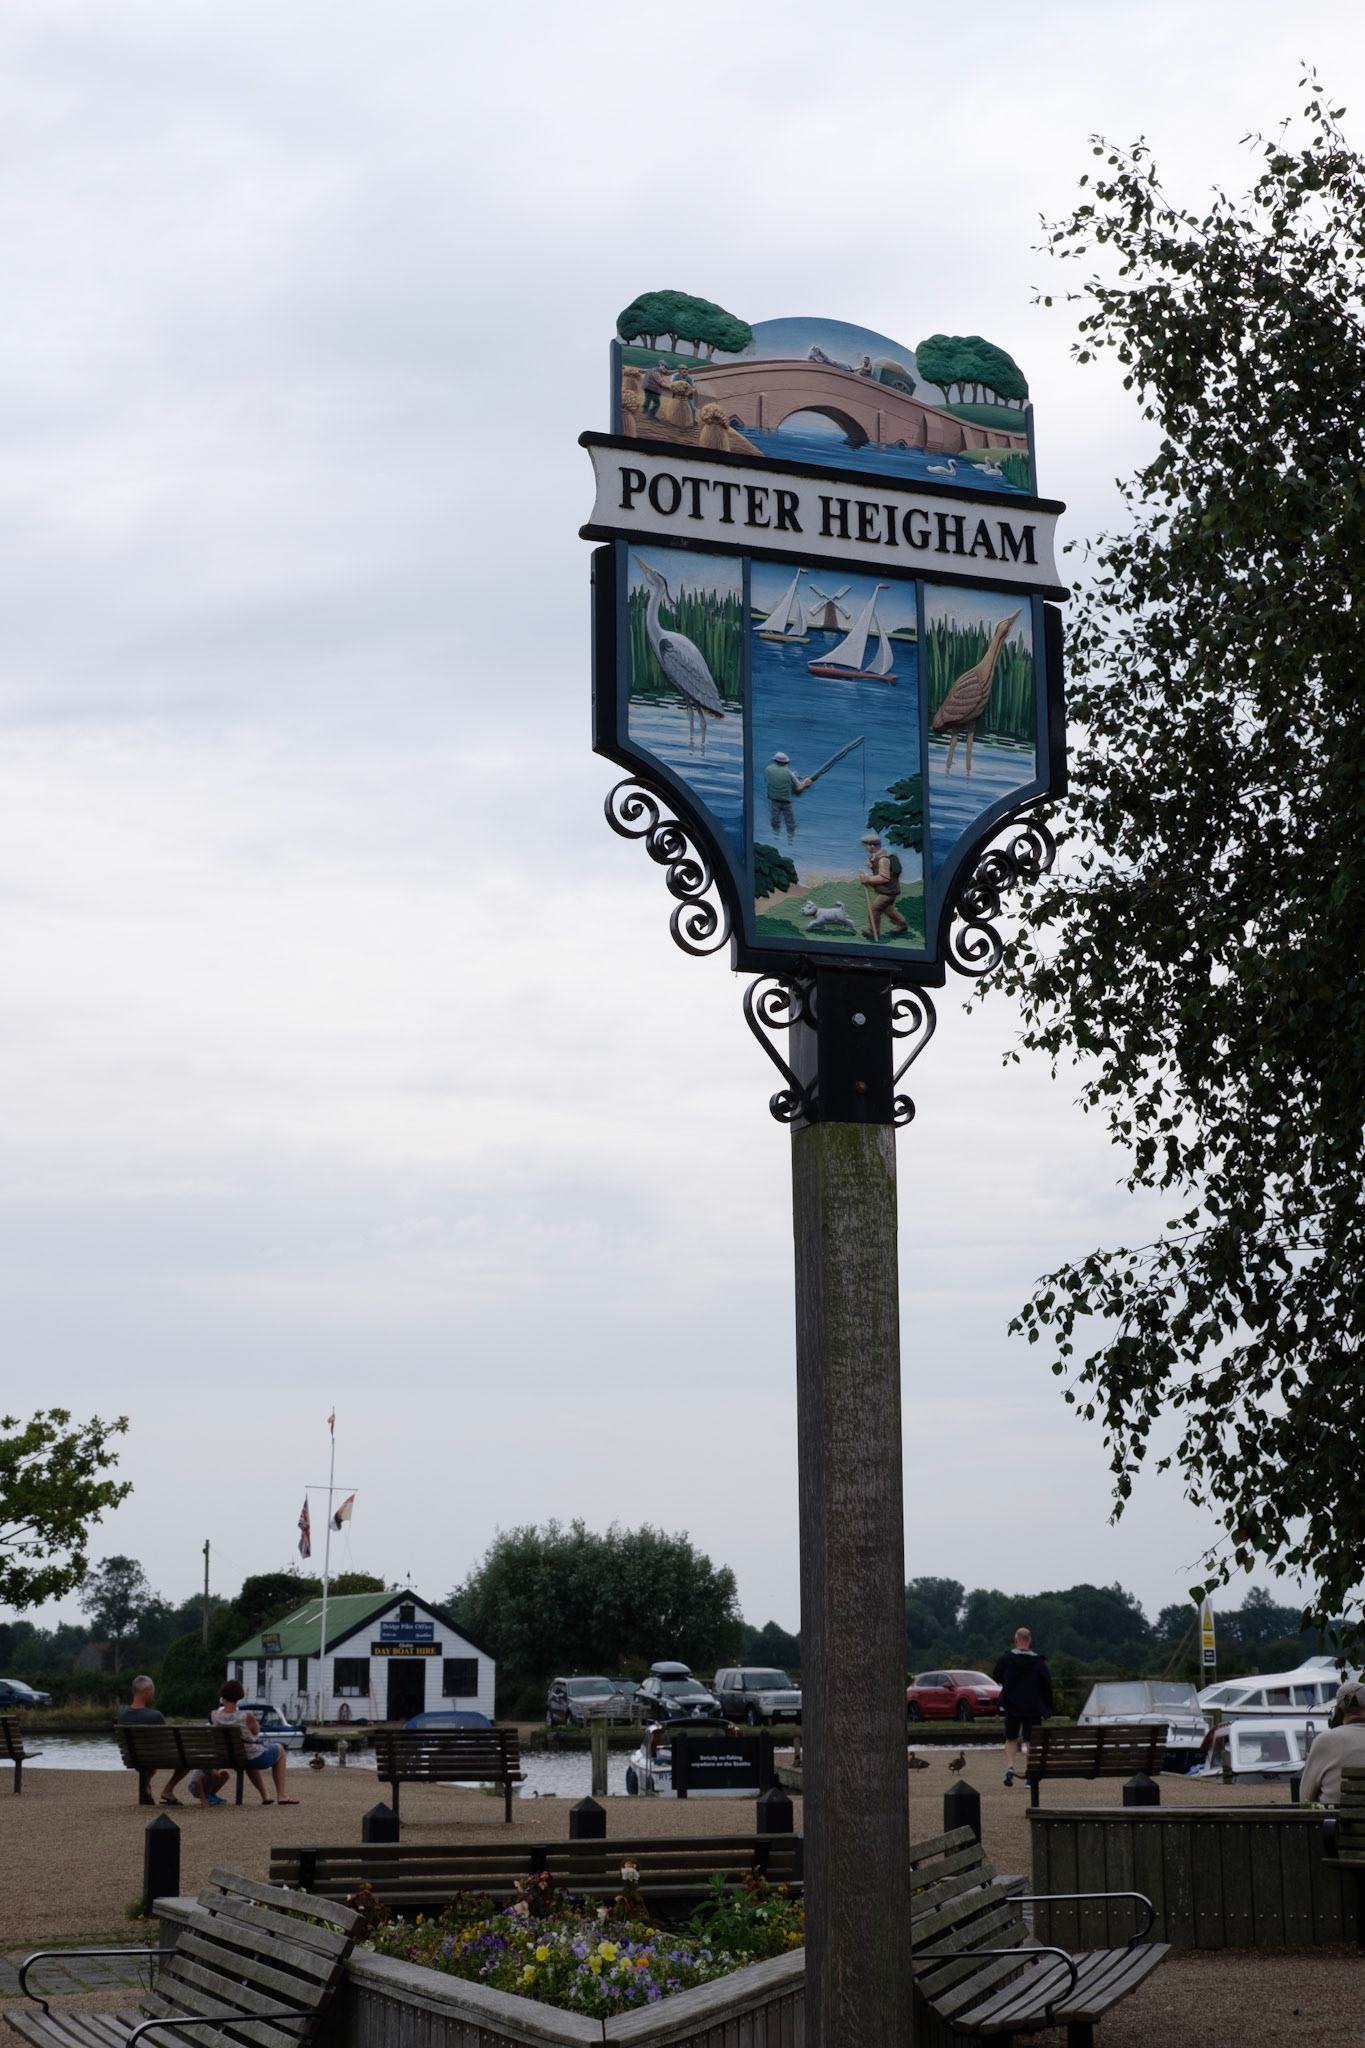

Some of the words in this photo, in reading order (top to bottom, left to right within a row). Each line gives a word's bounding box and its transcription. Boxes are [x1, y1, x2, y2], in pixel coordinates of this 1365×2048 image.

[618, 466, 803, 533] POTTER
[818, 495, 1039, 565] HEIGHAM
[382, 1623, 400, 1631] Bridge
[374, 1647, 391, 1655] DAY
[392, 1647, 415, 1655] BOAT
[416, 1647, 436, 1655] HIRE
